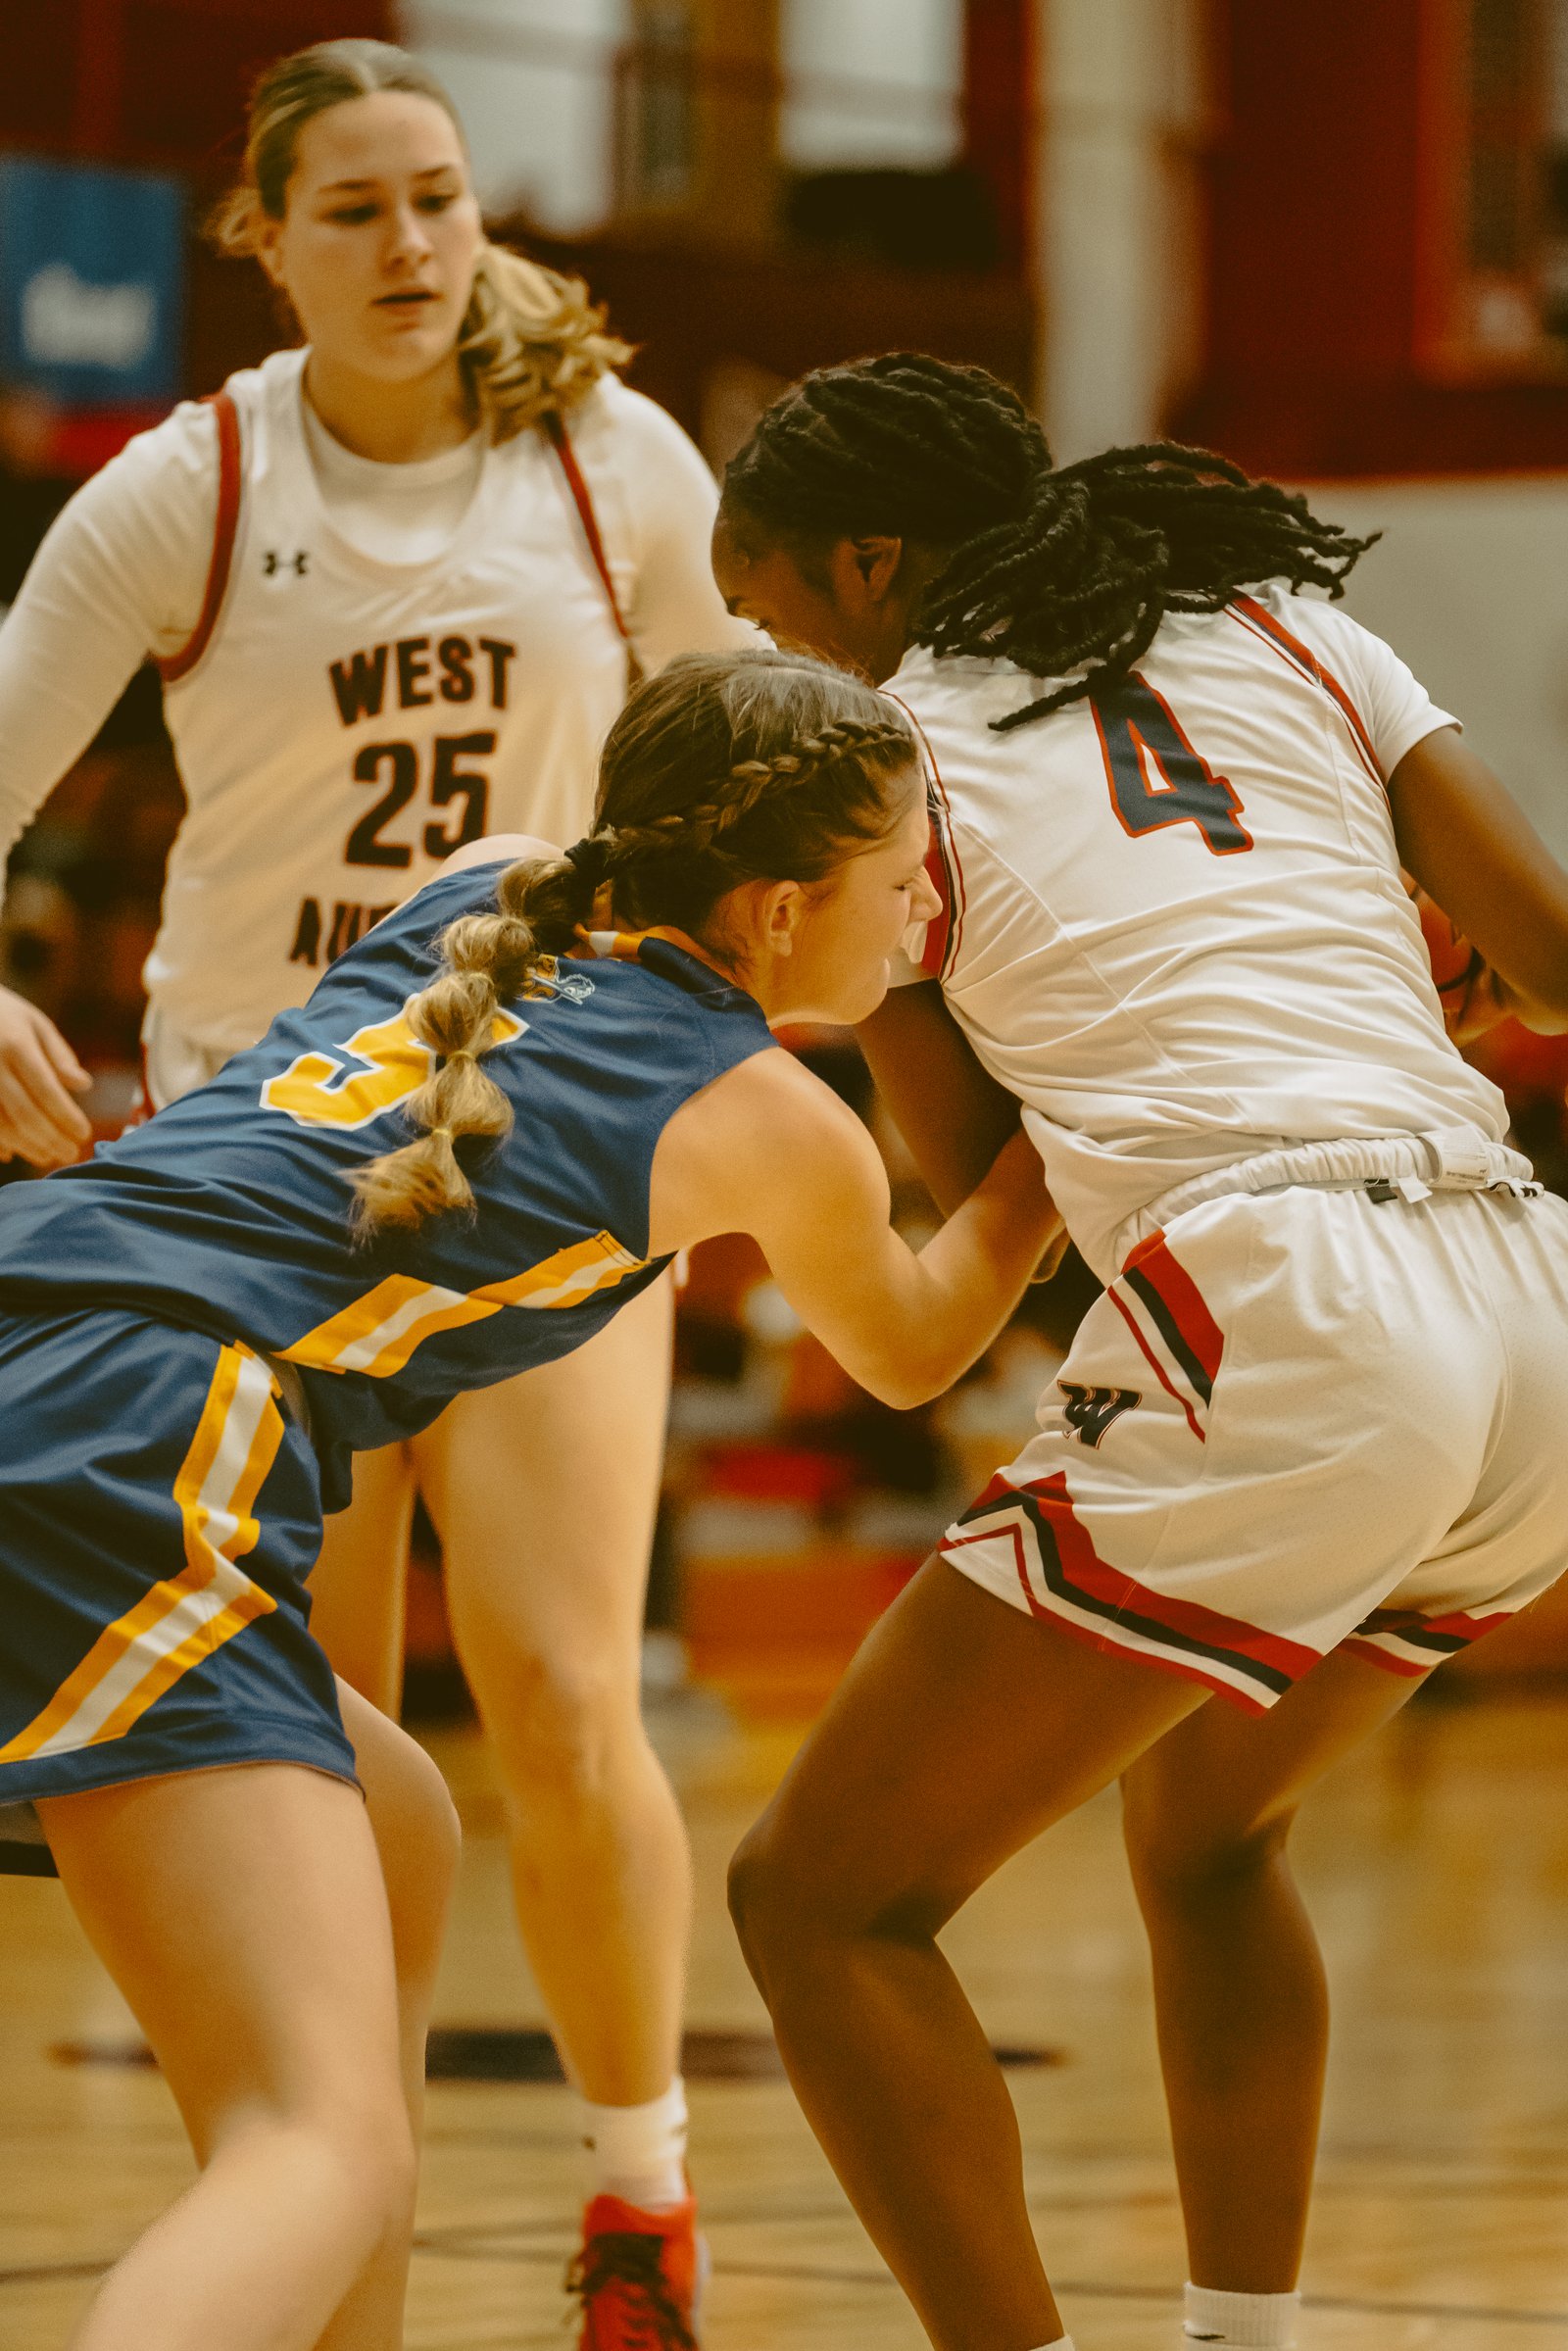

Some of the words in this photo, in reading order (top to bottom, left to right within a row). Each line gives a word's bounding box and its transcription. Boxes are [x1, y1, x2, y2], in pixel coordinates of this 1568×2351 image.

[328, 636, 517, 727] WEST
[344, 729, 498, 868] 25
[1089, 669, 1254, 857] 4
